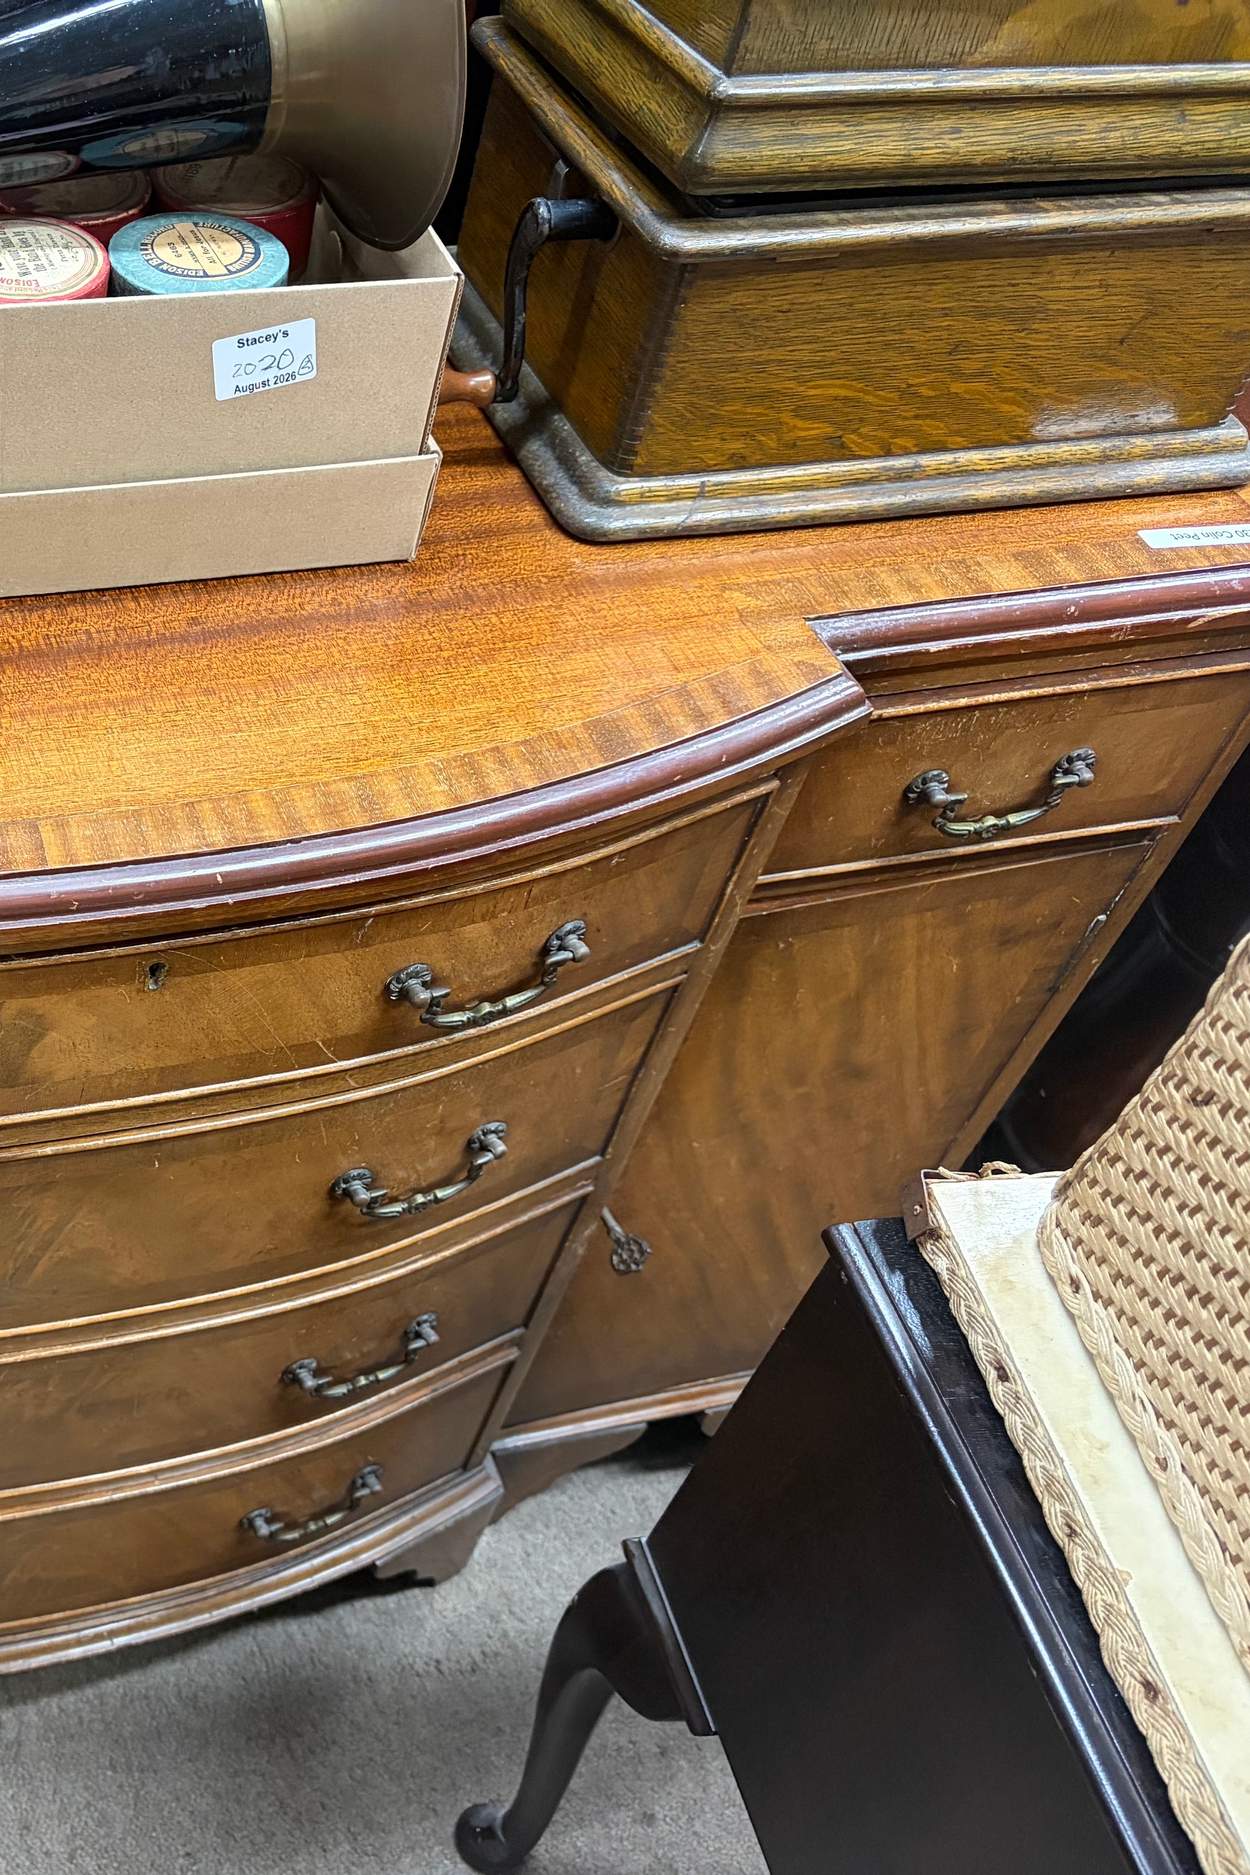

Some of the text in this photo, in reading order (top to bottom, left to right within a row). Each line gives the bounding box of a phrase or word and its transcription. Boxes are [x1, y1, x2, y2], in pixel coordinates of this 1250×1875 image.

[189, 229, 204, 245] Jesus
[140, 242, 161, 266] BELL
[200, 245, 212, 255] for
[206, 255, 218, 264] All
[32, 262, 48, 273] the
[160, 262, 204, 276] EDISON
[0, 277, 40, 288] EDISON
[237, 329, 290, 349] Stacey's
[233, 371, 297, 394] August 2026
[1201, 530, 1233, 540] Colin
